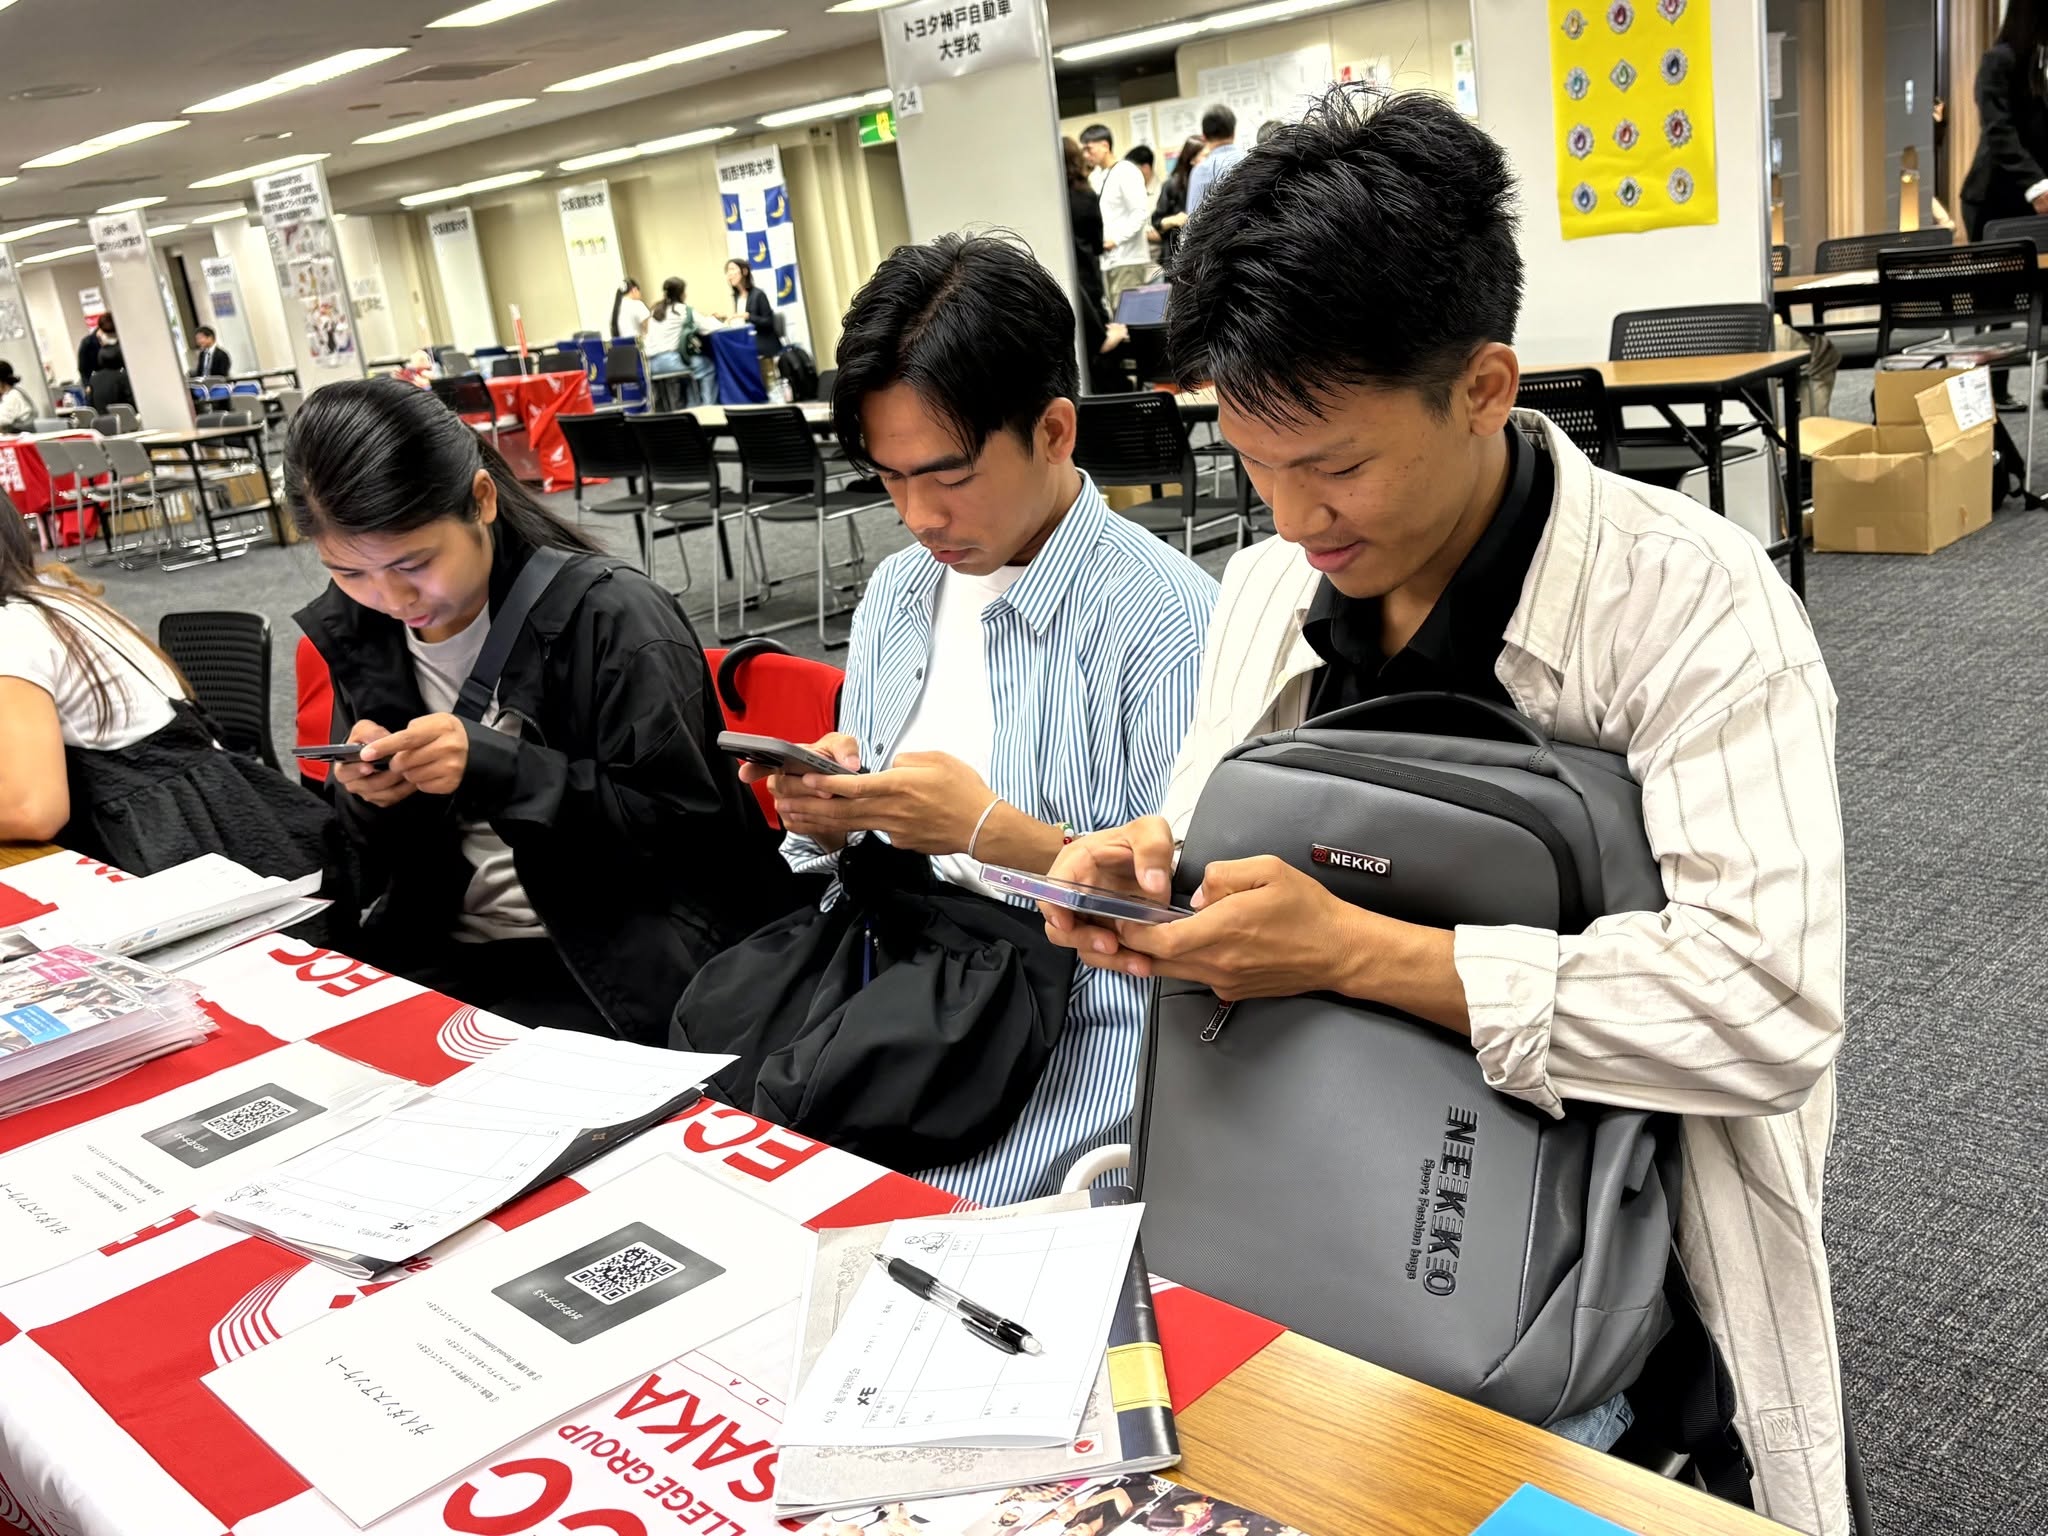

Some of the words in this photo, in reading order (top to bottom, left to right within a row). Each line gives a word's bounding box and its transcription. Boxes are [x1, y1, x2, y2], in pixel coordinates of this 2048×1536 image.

[904, 0, 1013, 42] トヨタ神戸自動車
[938, 33, 982, 61] 大学校
[899, 90, 918, 112] 24
[1330, 851, 1387, 874] NEKKO
[1420, 1158, 1436, 1195] Sport
[1422, 1105, 1480, 1297] NEKKO
[1411, 1197, 1430, 1246] Fashion
[1405, 1249, 1422, 1280] bags
[324, 1354, 435, 1437] ガイダンスアンケート
[857, 1386, 878, 1407] メモ
[557, 1424, 656, 1485] GROUP
